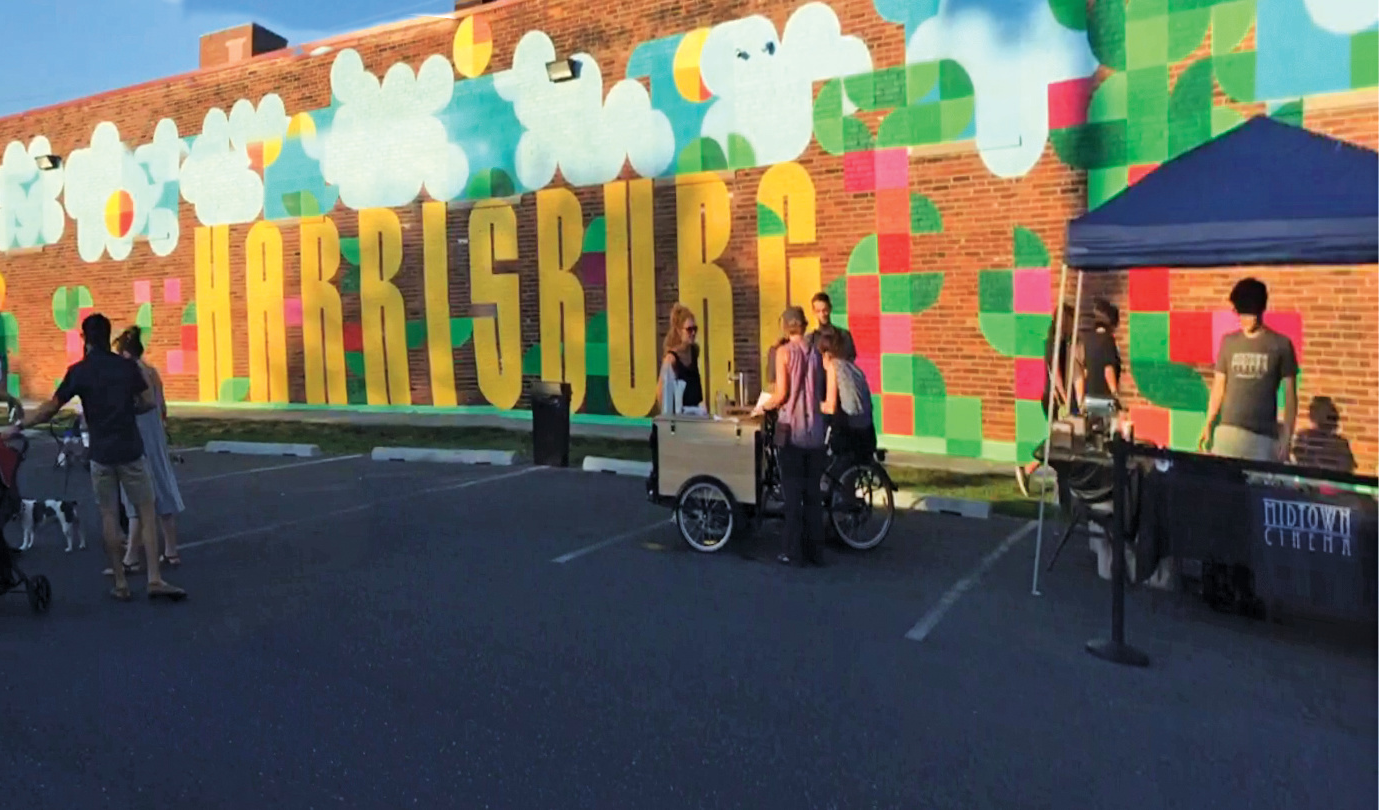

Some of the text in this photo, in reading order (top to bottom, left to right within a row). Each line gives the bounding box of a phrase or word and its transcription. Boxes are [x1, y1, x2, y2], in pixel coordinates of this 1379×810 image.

[194, 162, 821, 418] HARRISBURG
[1263, 498, 1352, 538] MIDTOWN
[1264, 527, 1352, 557] CINEMA
